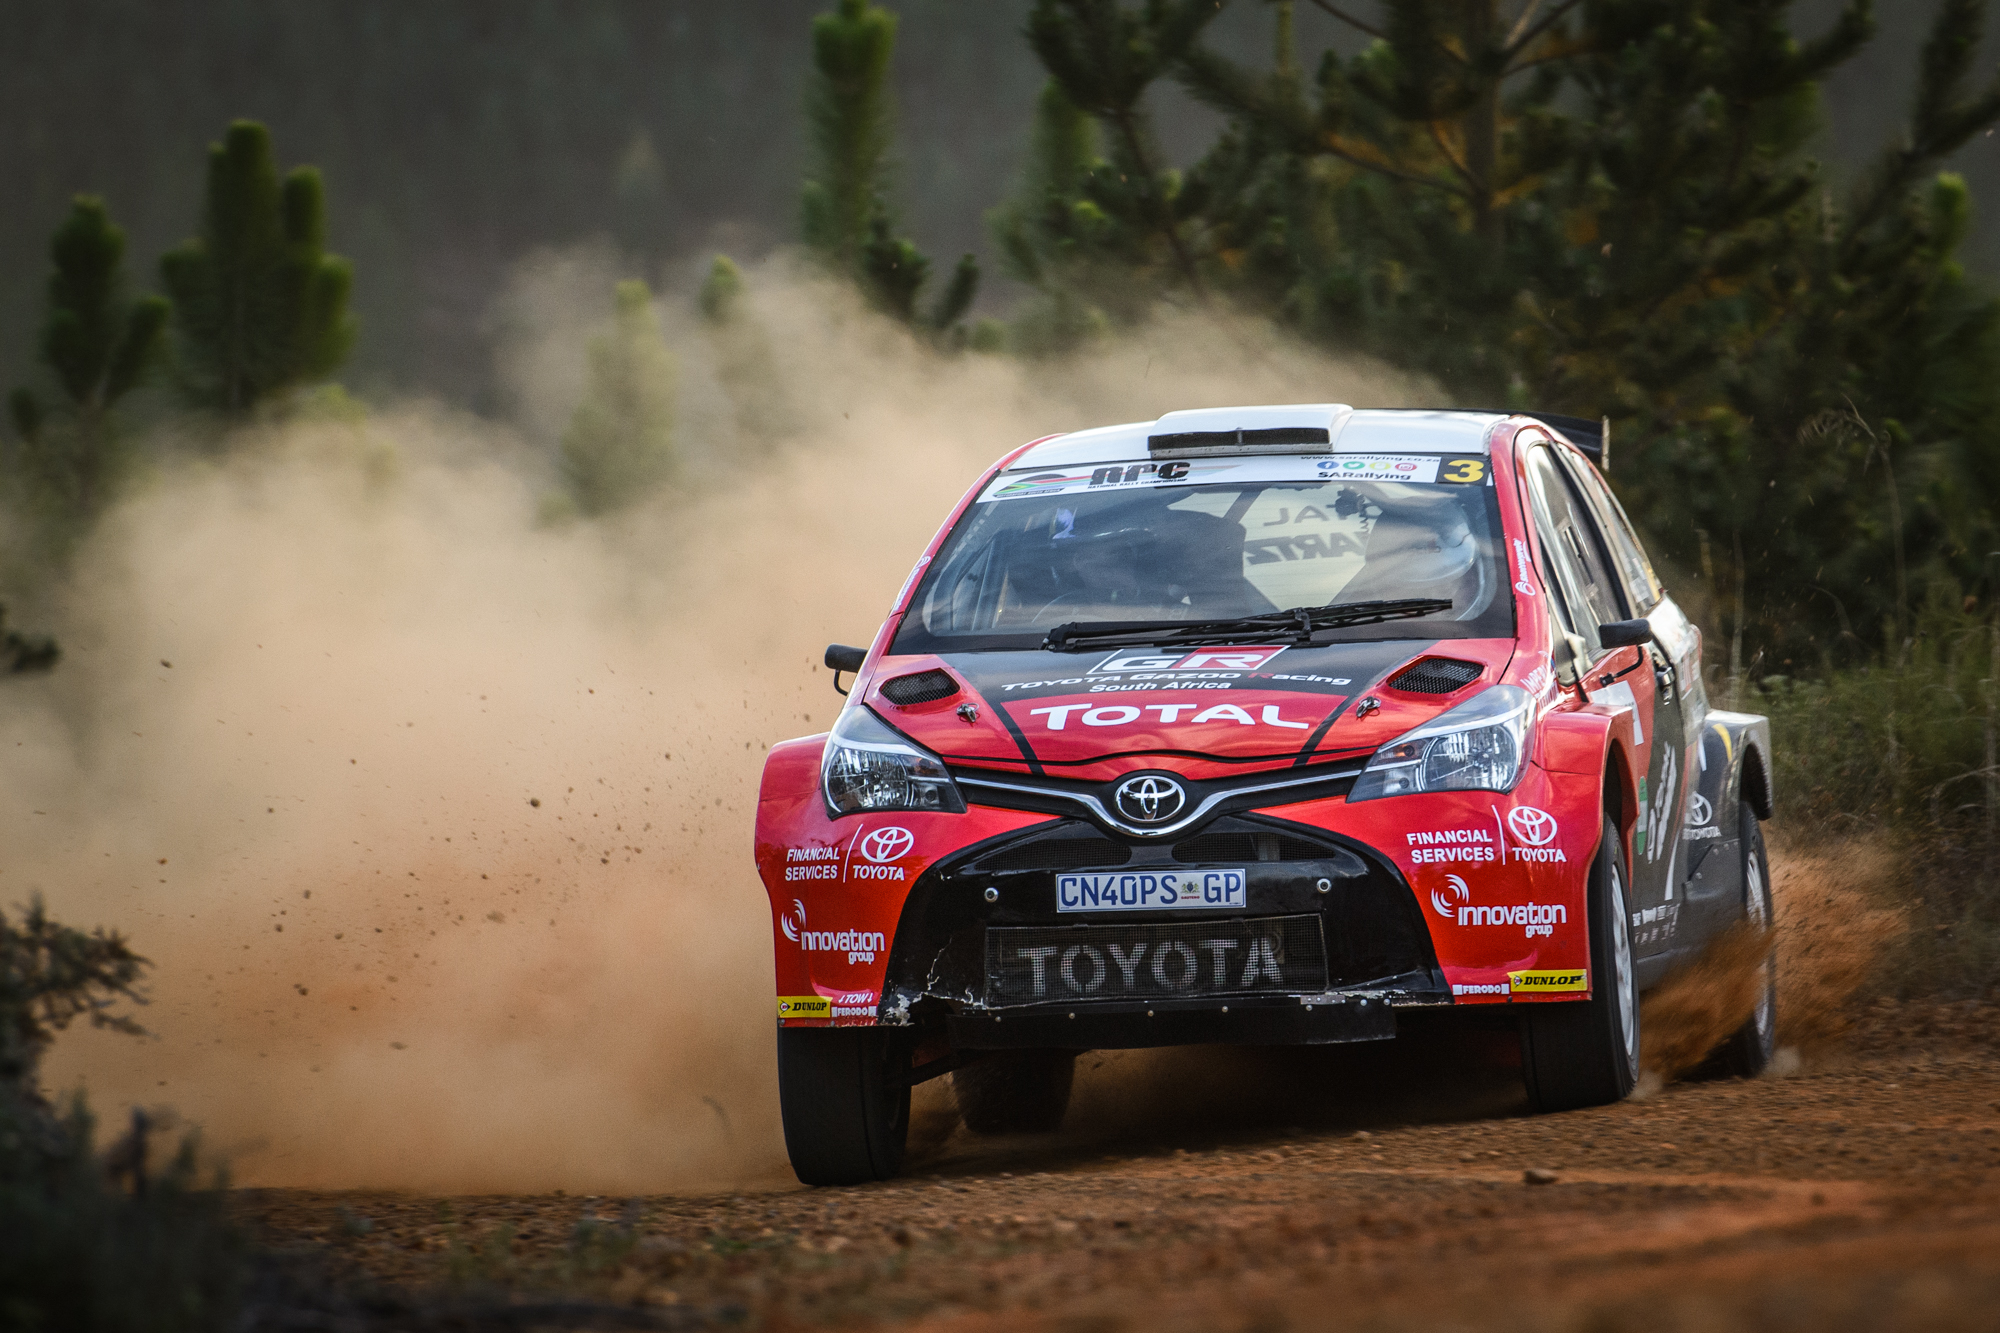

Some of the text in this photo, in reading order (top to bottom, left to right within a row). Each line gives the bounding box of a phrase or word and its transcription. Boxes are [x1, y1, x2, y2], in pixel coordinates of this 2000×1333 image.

[1089, 461, 1191, 485] nrc
[1318, 471, 1412, 481] SARallying
[1443, 459, 1485, 482] 3
[1102, 653, 1264, 671] GR
[1002, 672, 1352, 691] TOYOTA GAZOO Racing
[1089, 680, 1232, 692] South Africa
[1030, 703, 1309, 730] TOTAL
[1406, 829, 1493, 845] FINANCIAL
[786, 847, 840, 862] FINANCIAL
[1411, 847, 1495, 863] SERVICES
[1512, 847, 1567, 863] TOYOTA
[785, 864, 838, 881] SERVICES
[853, 864, 905, 881] TOYOTA
[1060, 873, 1241, 907] CN40PS GP
[1458, 901, 1567, 926] innovation
[801, 928, 885, 951] innovation
[1525, 924, 1553, 939] group
[848, 951, 875, 965] group
[1018, 937, 1284, 997] TOYOTA
[1524, 975, 1582, 985] DUNLOP
[1462, 984, 1501, 994] FERODO
[844, 993, 869, 1004] TOW
[792, 1002, 828, 1012] DUNLOP
[837, 1006, 868, 1016] FERODO
